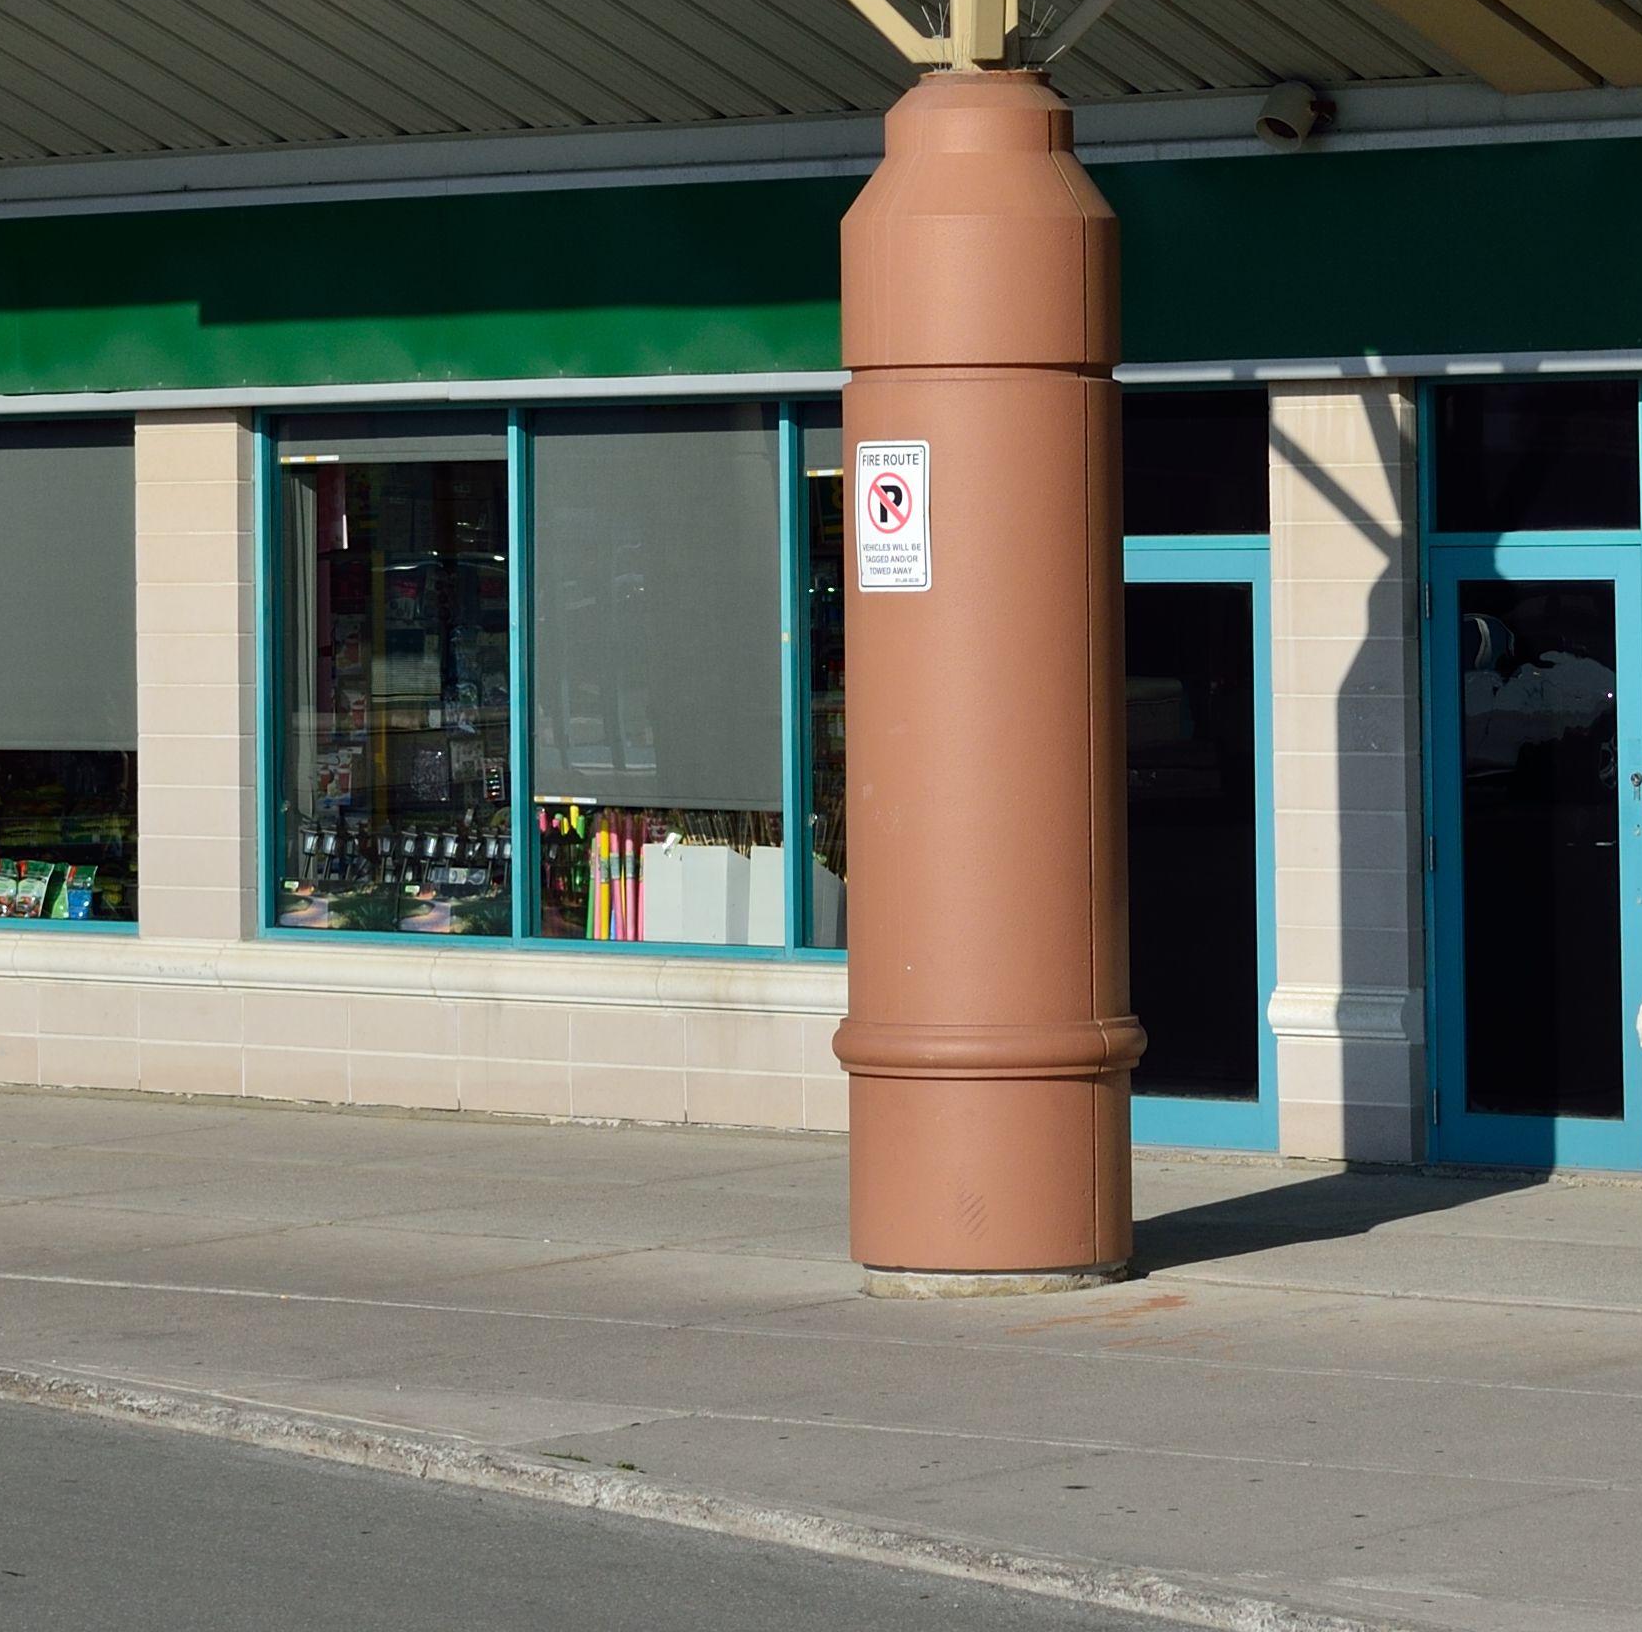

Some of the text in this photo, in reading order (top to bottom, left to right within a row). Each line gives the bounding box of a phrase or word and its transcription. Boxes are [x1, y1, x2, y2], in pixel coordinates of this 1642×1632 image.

[862, 453, 920, 466] FIRE ROUTE
[862, 543, 922, 552] VEHICLES WILL BE
[865, 555, 919, 563] TAGGED AND/OR
[869, 567, 913, 575] TOWED AWAY
